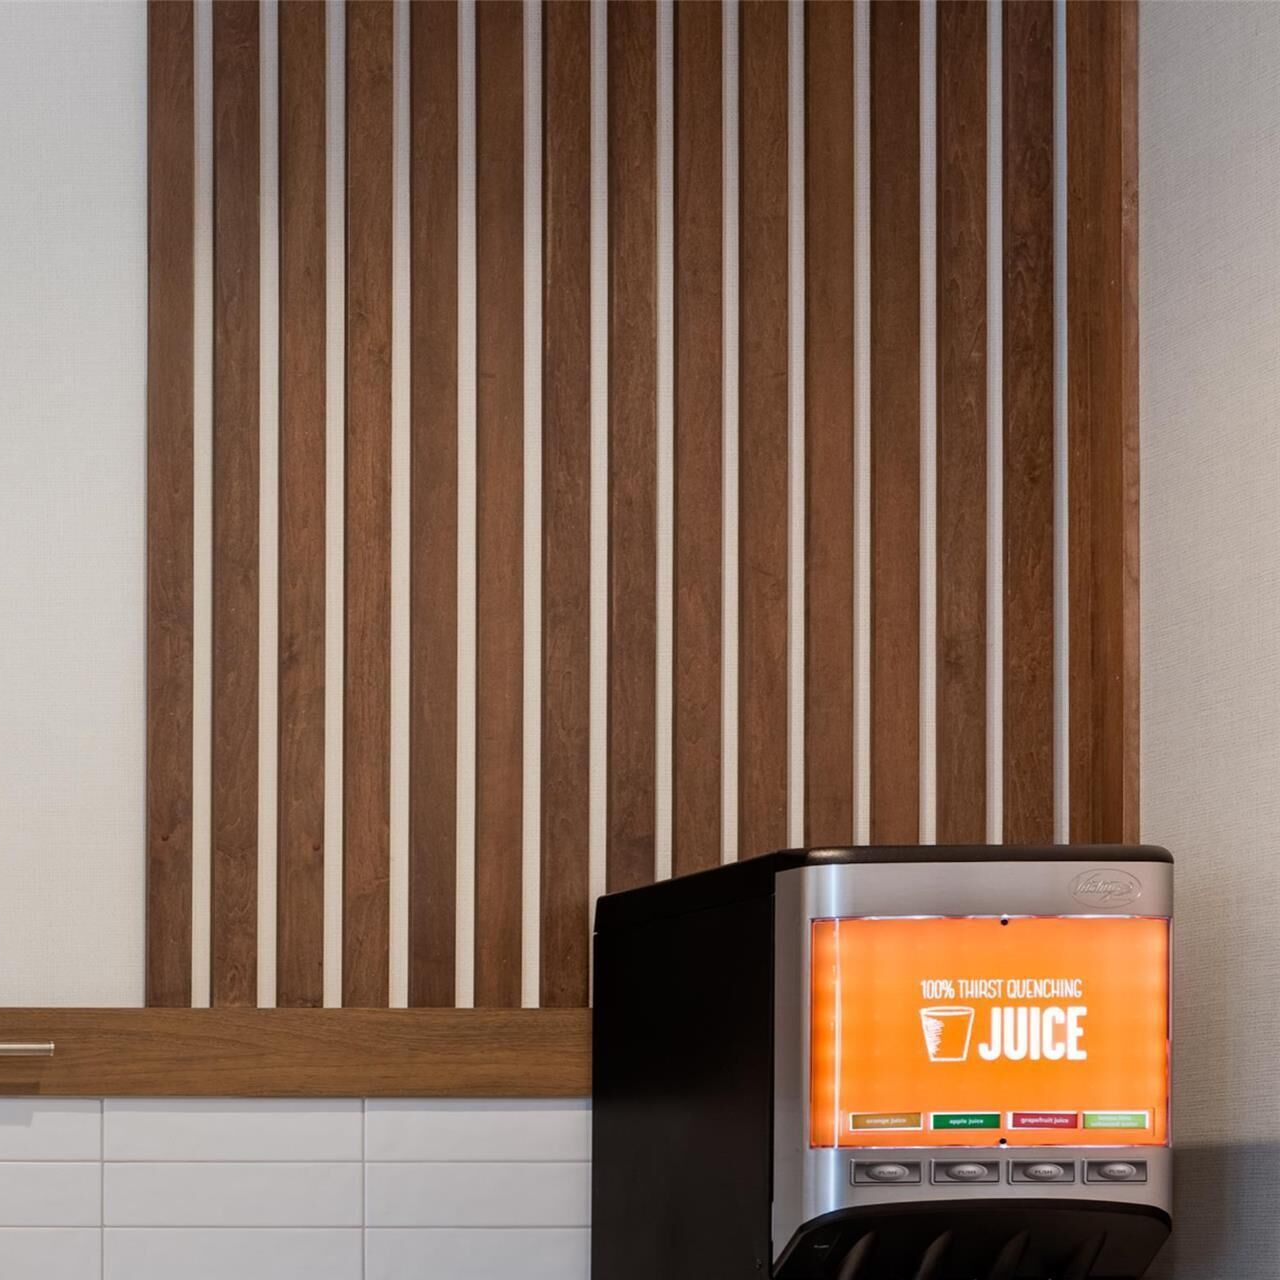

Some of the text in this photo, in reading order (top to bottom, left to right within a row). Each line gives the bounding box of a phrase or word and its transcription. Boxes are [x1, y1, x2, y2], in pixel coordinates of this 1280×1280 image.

[920, 979, 1082, 999] 100% THIRST QUENCHING
[978, 1006, 1088, 1061] JUICE
